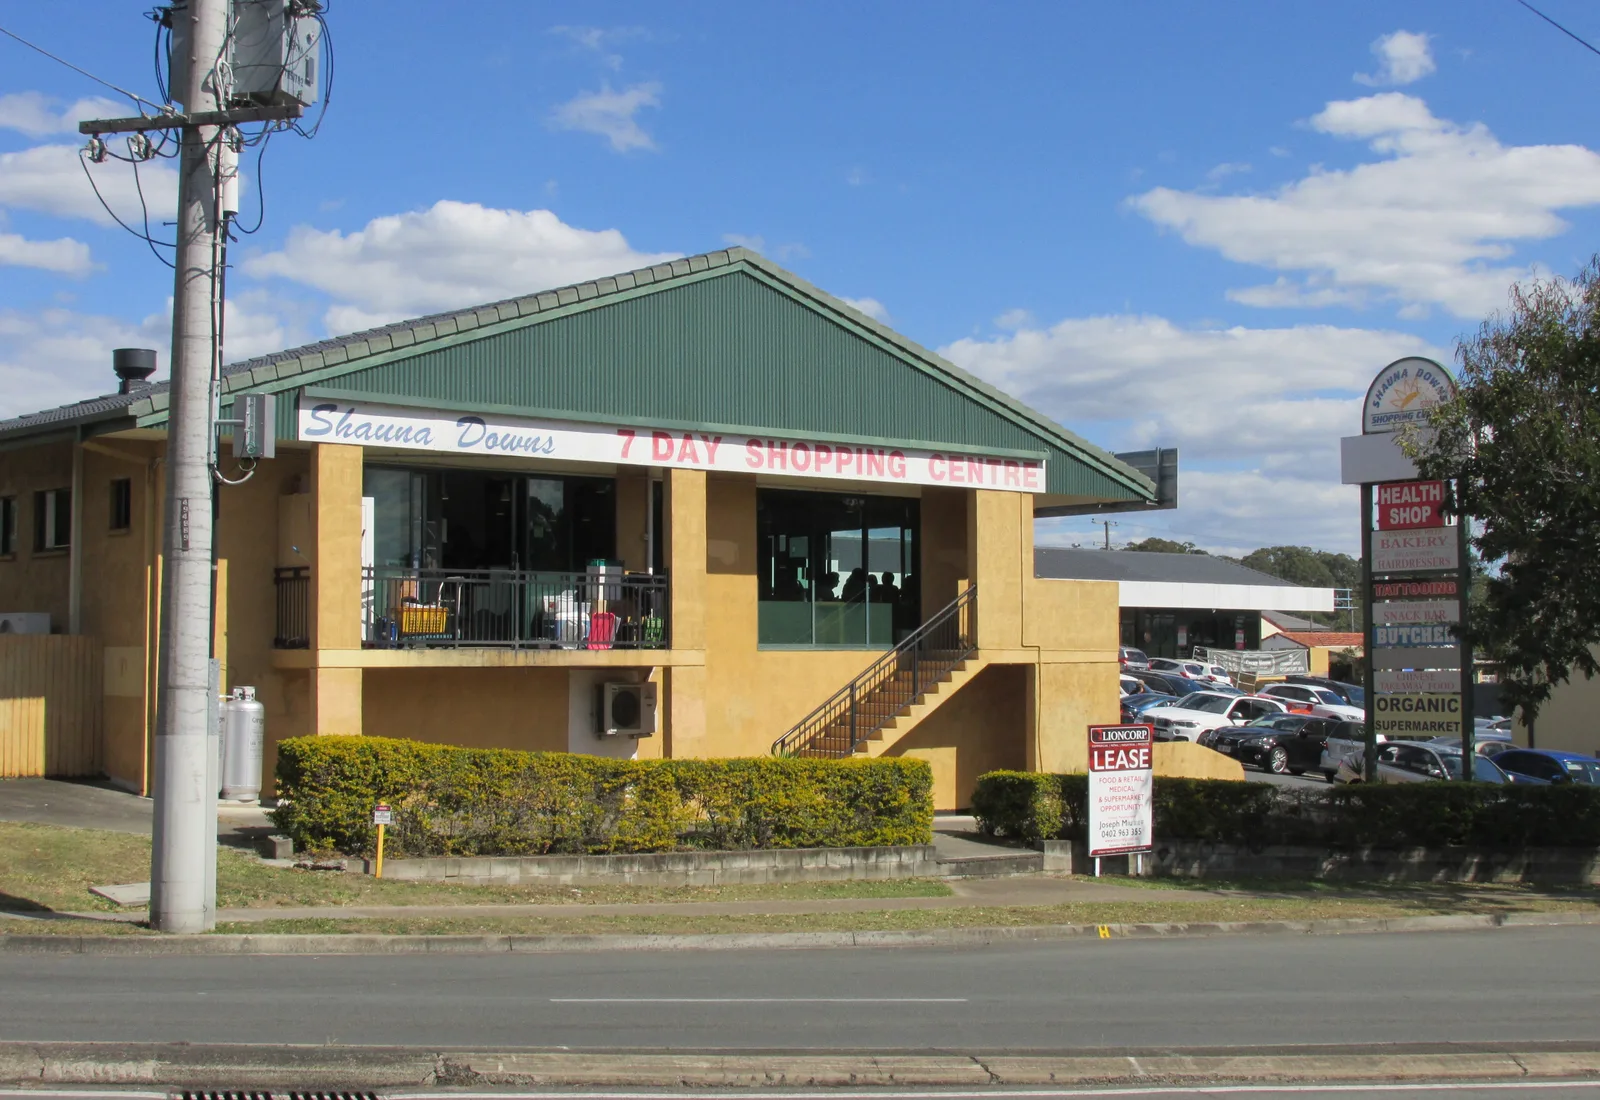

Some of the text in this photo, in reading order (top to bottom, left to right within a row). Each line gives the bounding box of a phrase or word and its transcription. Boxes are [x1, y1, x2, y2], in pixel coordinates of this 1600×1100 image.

[1373, 368, 1448, 408] SHAUNA DOWNS
[1372, 411, 1414, 424] SHOPPING
[304, 403, 1039, 488] Shauna Downs 7 DAY SHOPPING CENTRE
[1380, 484, 1440, 505] HEALTH
[1390, 506, 1431, 525] SHOP
[1380, 536, 1448, 549] BAKERY
[1378, 557, 1451, 570] HAIRDRESSERS
[1374, 582, 1456, 596] TATTOOING
[1384, 610, 1446, 622] SNACK BAR
[1396, 672, 1436, 682] CHINESE
[1380, 681, 1454, 691] TAKEAWAY FOOD
[1376, 697, 1459, 713] ORGANIC
[1375, 719, 1460, 733] SUPERMARKET
[1102, 729, 1147, 741] LIONCORP
[1094, 748, 1149, 770] LEASE
[1104, 794, 1144, 802] SUPERMARKET
[1099, 820, 1120, 830] Joseph
[1101, 828, 1142, 838] 0402 963 355
